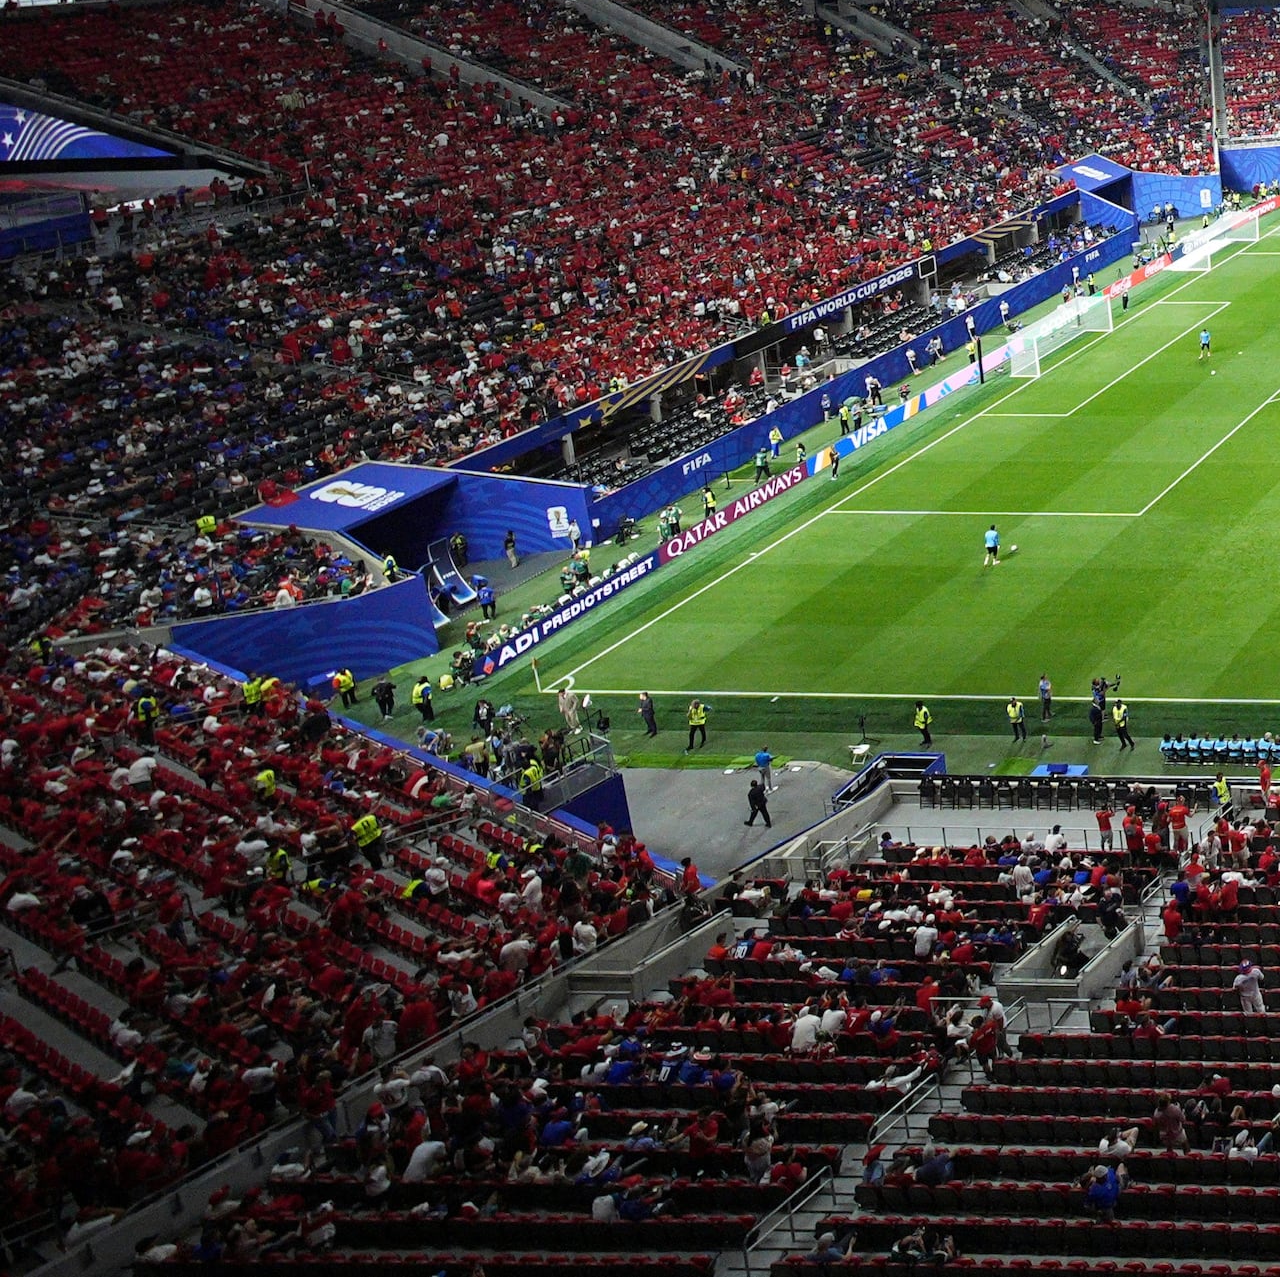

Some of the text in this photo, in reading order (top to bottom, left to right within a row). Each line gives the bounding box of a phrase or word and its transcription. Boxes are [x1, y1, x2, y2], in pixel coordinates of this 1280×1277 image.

[1248, 201, 1276, 221] enovo
[1085, 249, 1100, 263] FIFA
[791, 267, 913, 330] FIFA WORLD CUP 2026
[849, 417, 888, 449] VISA
[682, 452, 713, 476] FIFA
[666, 466, 803, 557] QATAR AIRWAYS
[498, 557, 654, 667] ADI PREDICTSTREET
